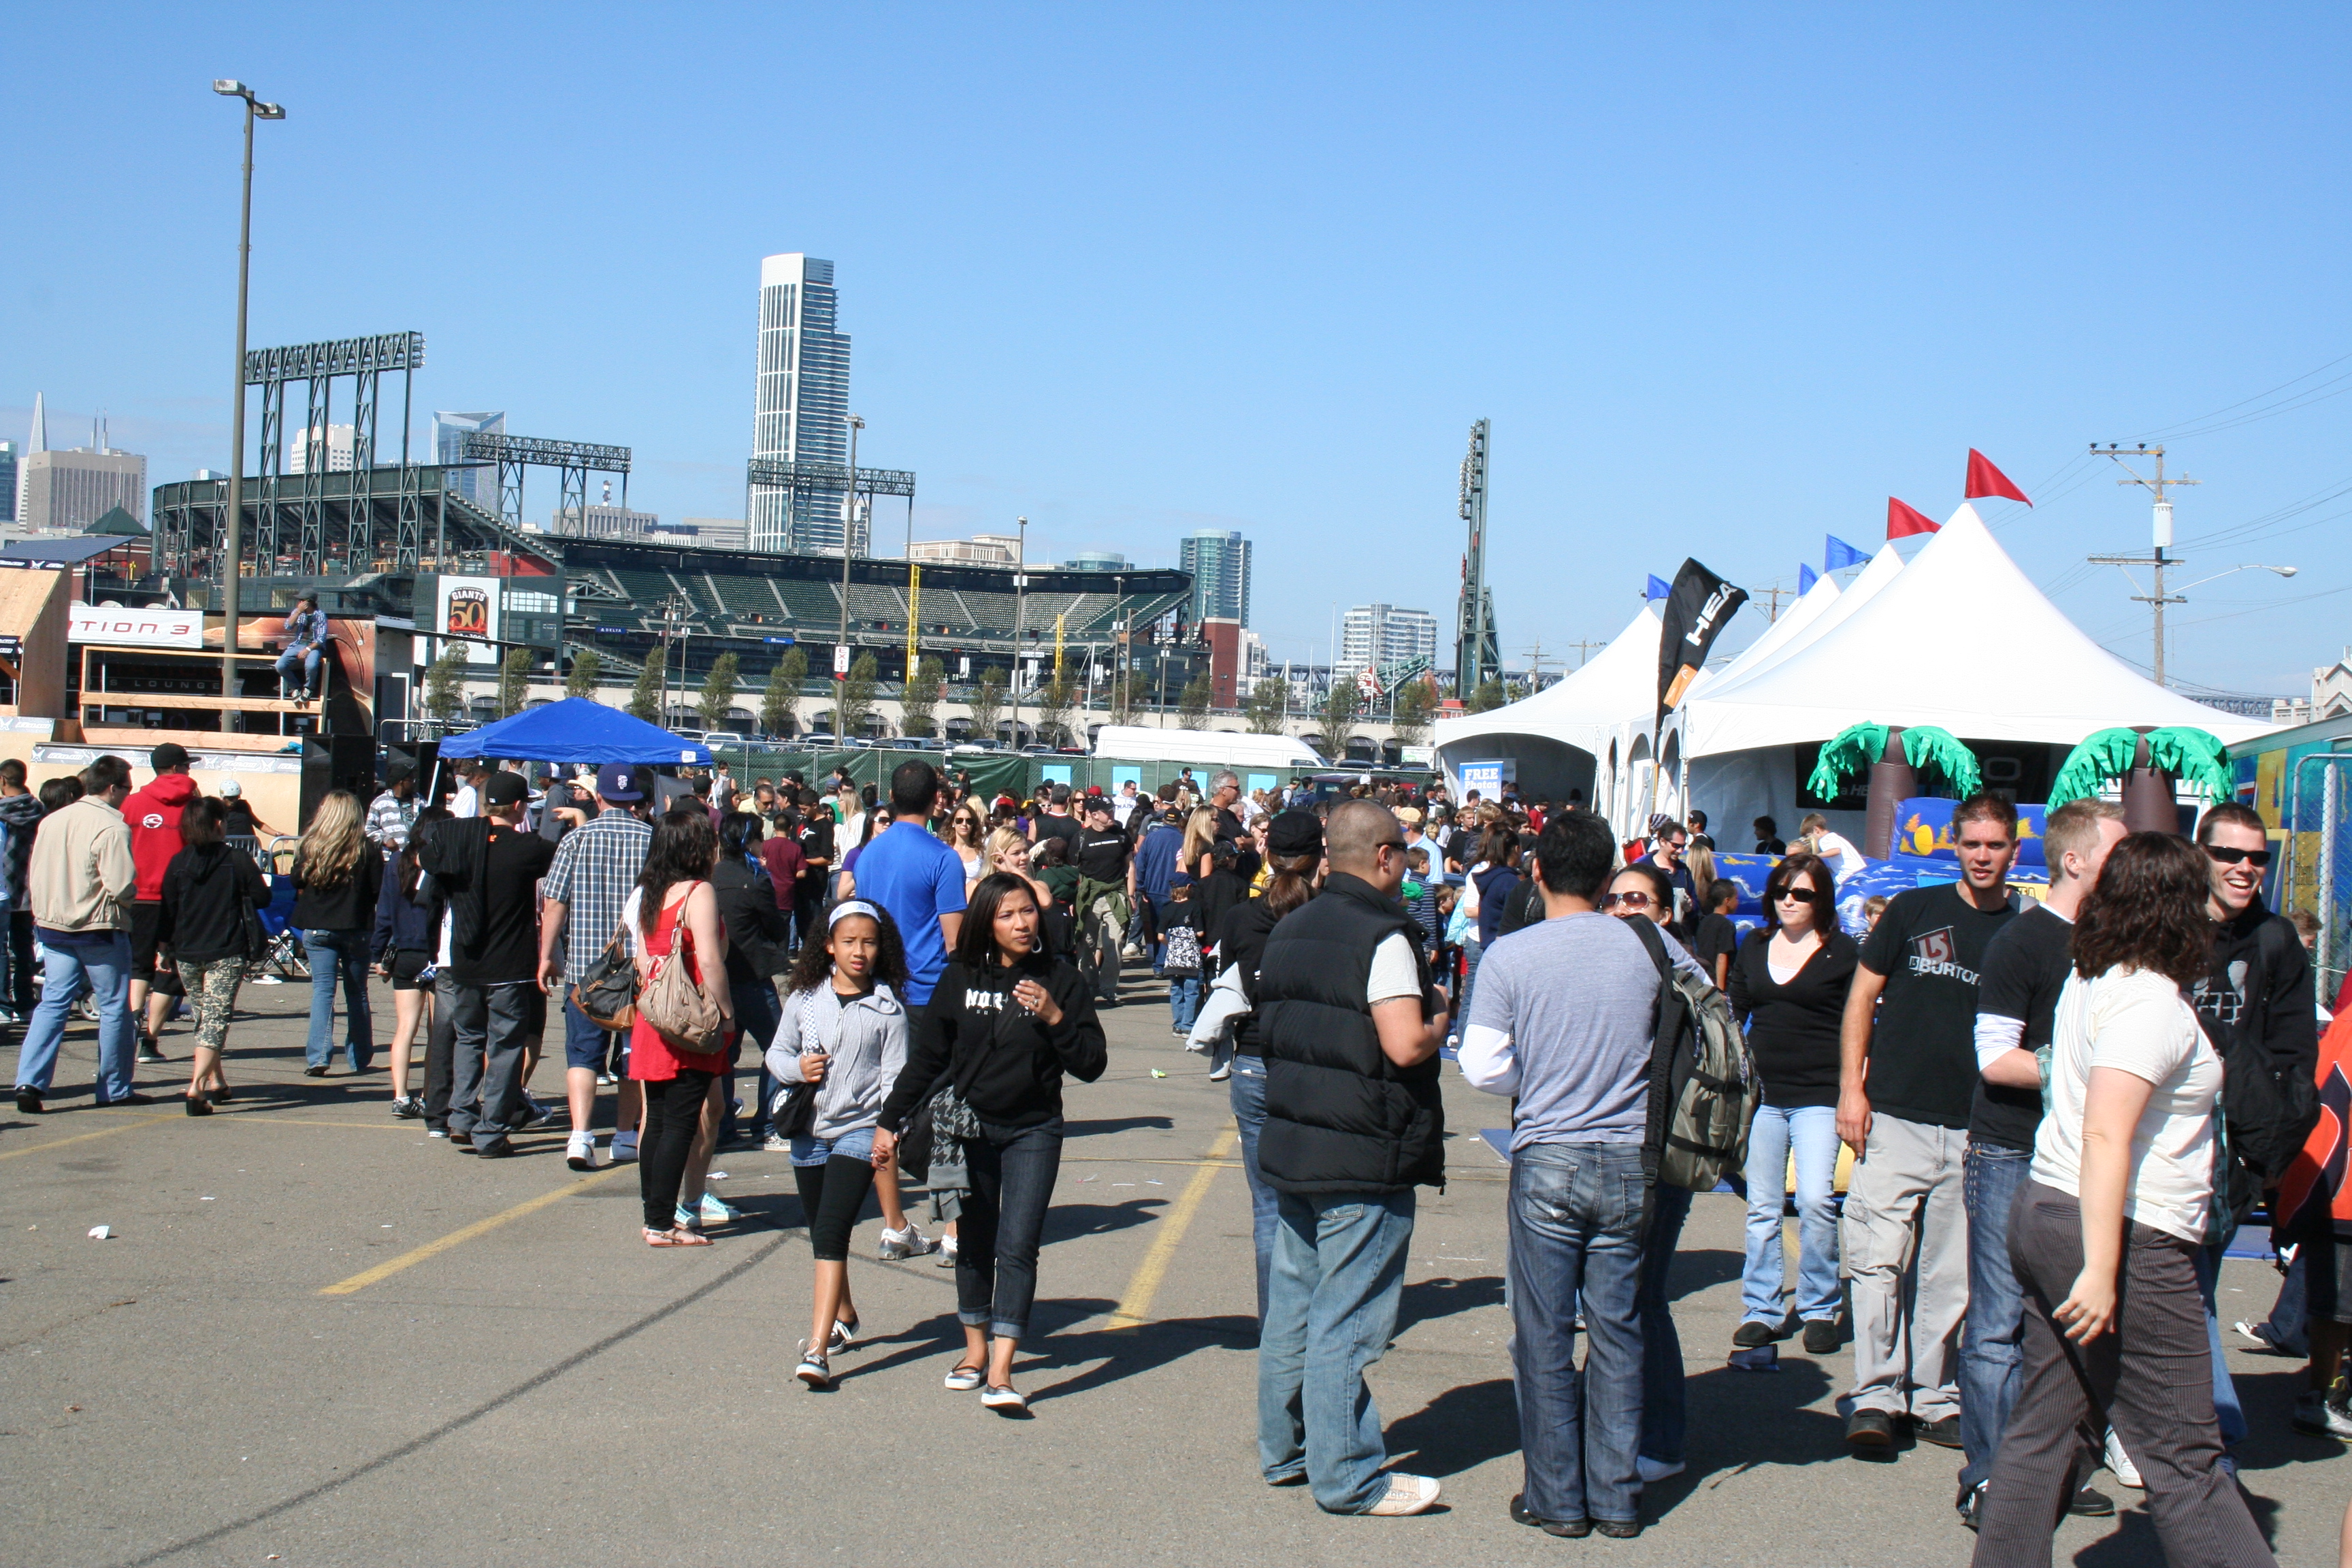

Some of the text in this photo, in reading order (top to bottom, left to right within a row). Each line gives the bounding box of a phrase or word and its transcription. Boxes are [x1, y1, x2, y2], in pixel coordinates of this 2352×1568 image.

[451, 590, 486, 602] GIANTS
[451, 601, 486, 628] 50
[1685, 583, 1737, 646] HEA
[67, 621, 190, 635] TION 3
[837, 647, 847, 671] EXIT
[134, 680, 220, 689] LOUNGE
[1465, 768, 1499, 780] FREE
[1465, 781, 1497, 789] Photos
[1850, 784, 1868, 796] HE
